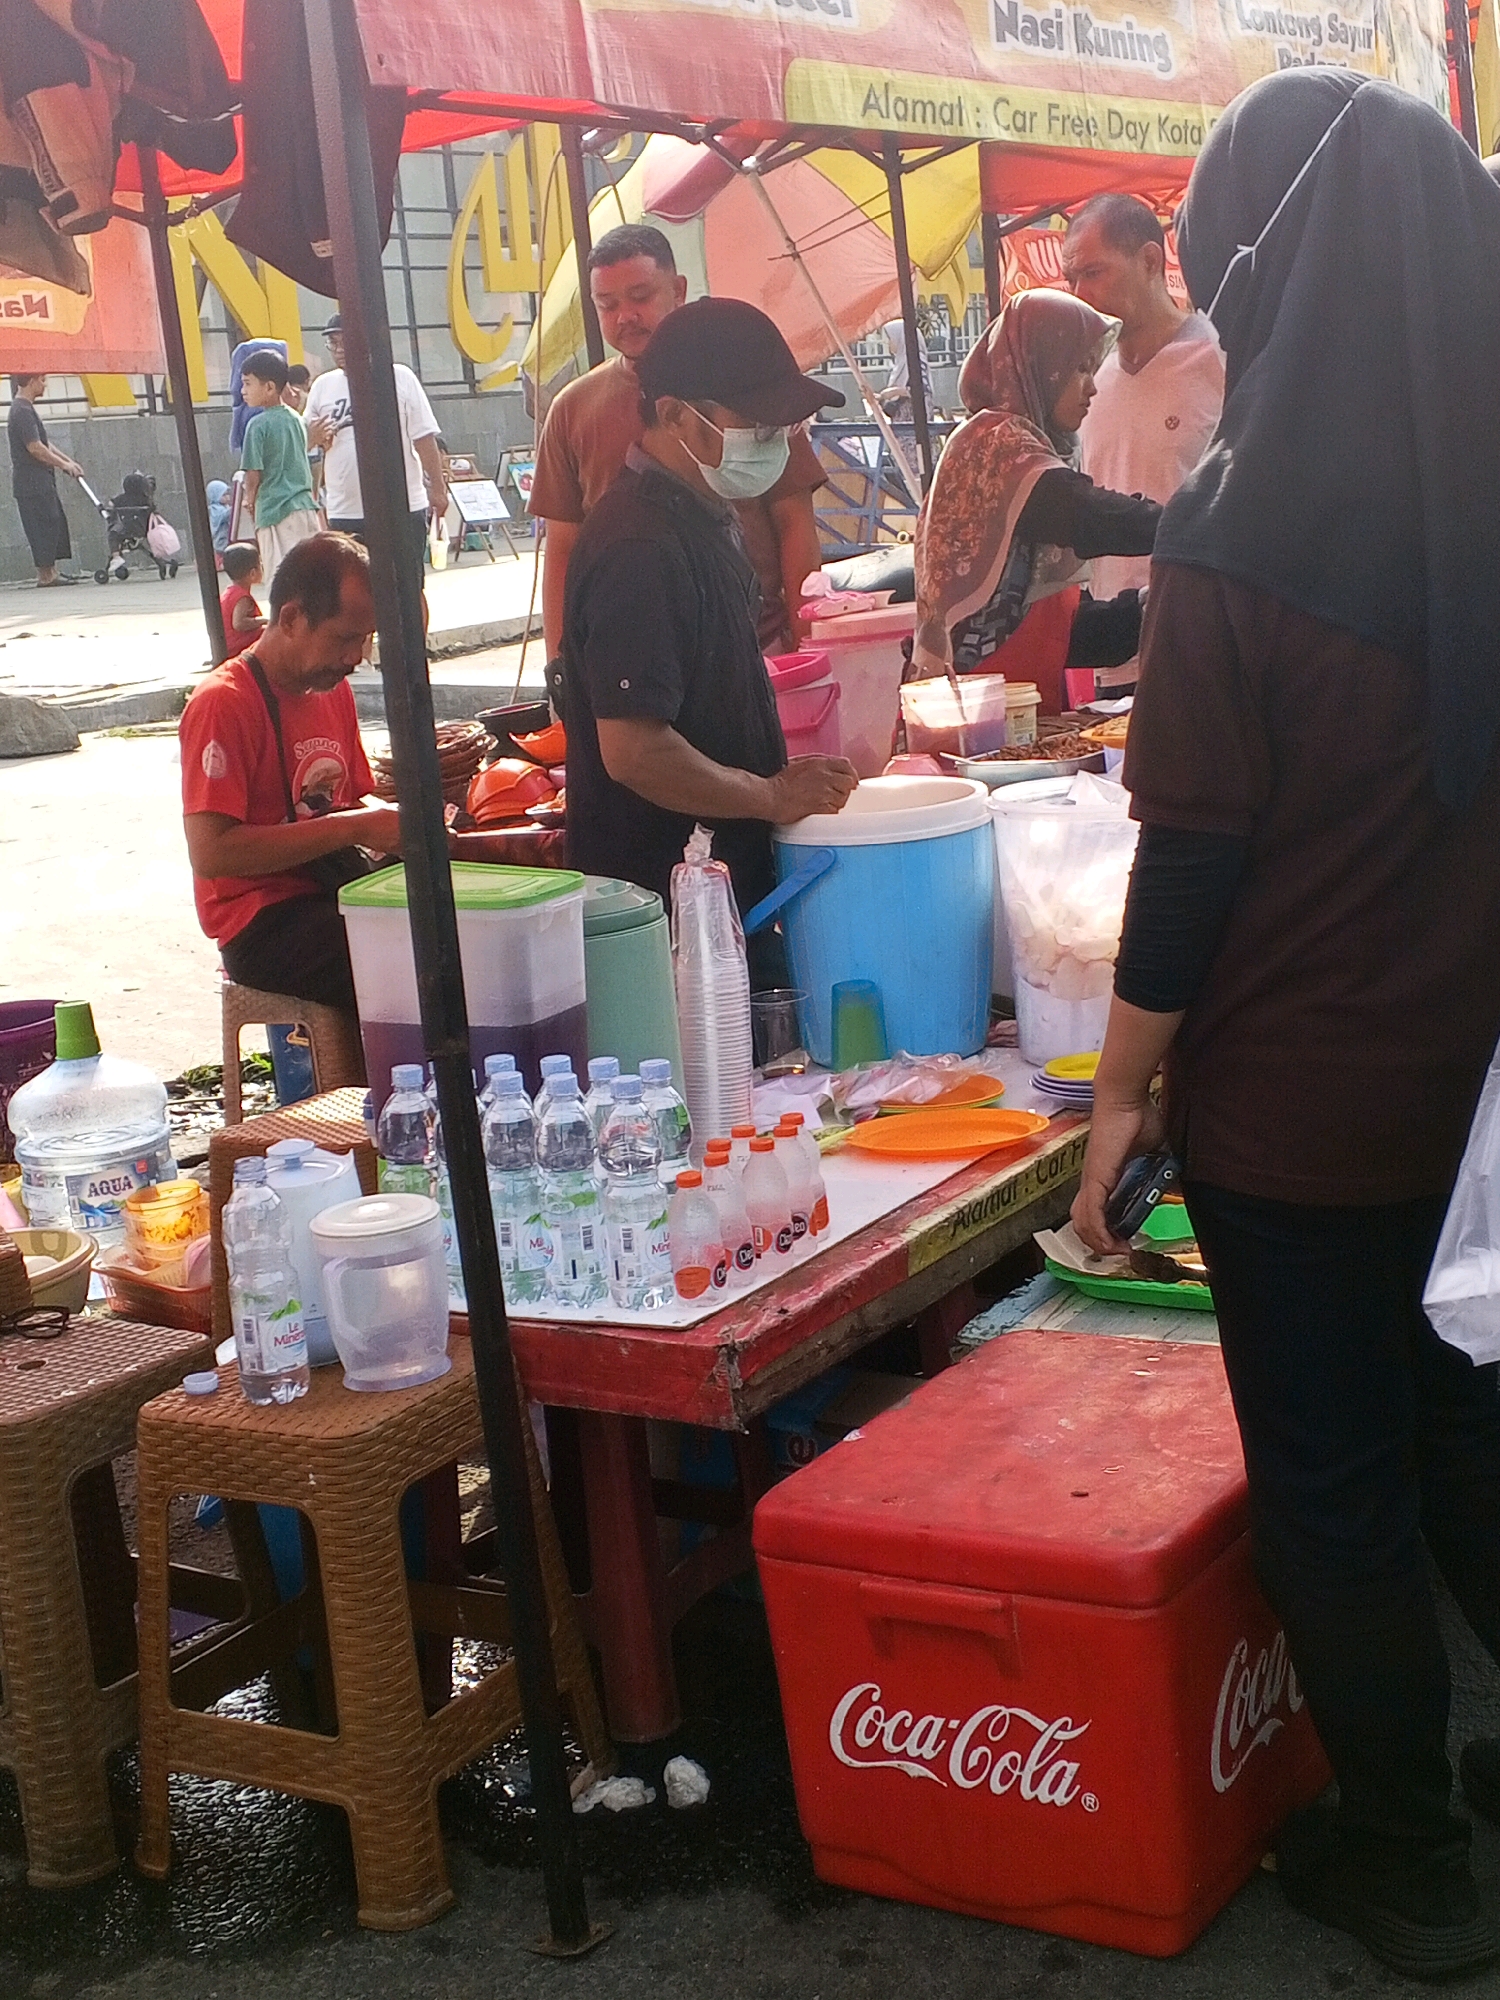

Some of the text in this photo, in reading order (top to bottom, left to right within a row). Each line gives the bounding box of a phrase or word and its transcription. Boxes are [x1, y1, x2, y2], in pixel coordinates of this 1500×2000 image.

[994, 0, 1172, 73] Nasi Kuning
[1327, 13, 1373, 53] Sayur
[861, 82, 964, 127] Alamat
[993, 97, 1038, 134] Car
[1047, 103, 1098, 138] Free
[1107, 108, 1150, 150] Day
[1158, 113, 1205, 146] Kota
[87, 1175, 134, 1199] AQUA
[1035, 1154, 1067, 1185] Car
[287, 1321, 300, 1334] Le
[829, 1682, 1092, 1807] Coca-Cola
